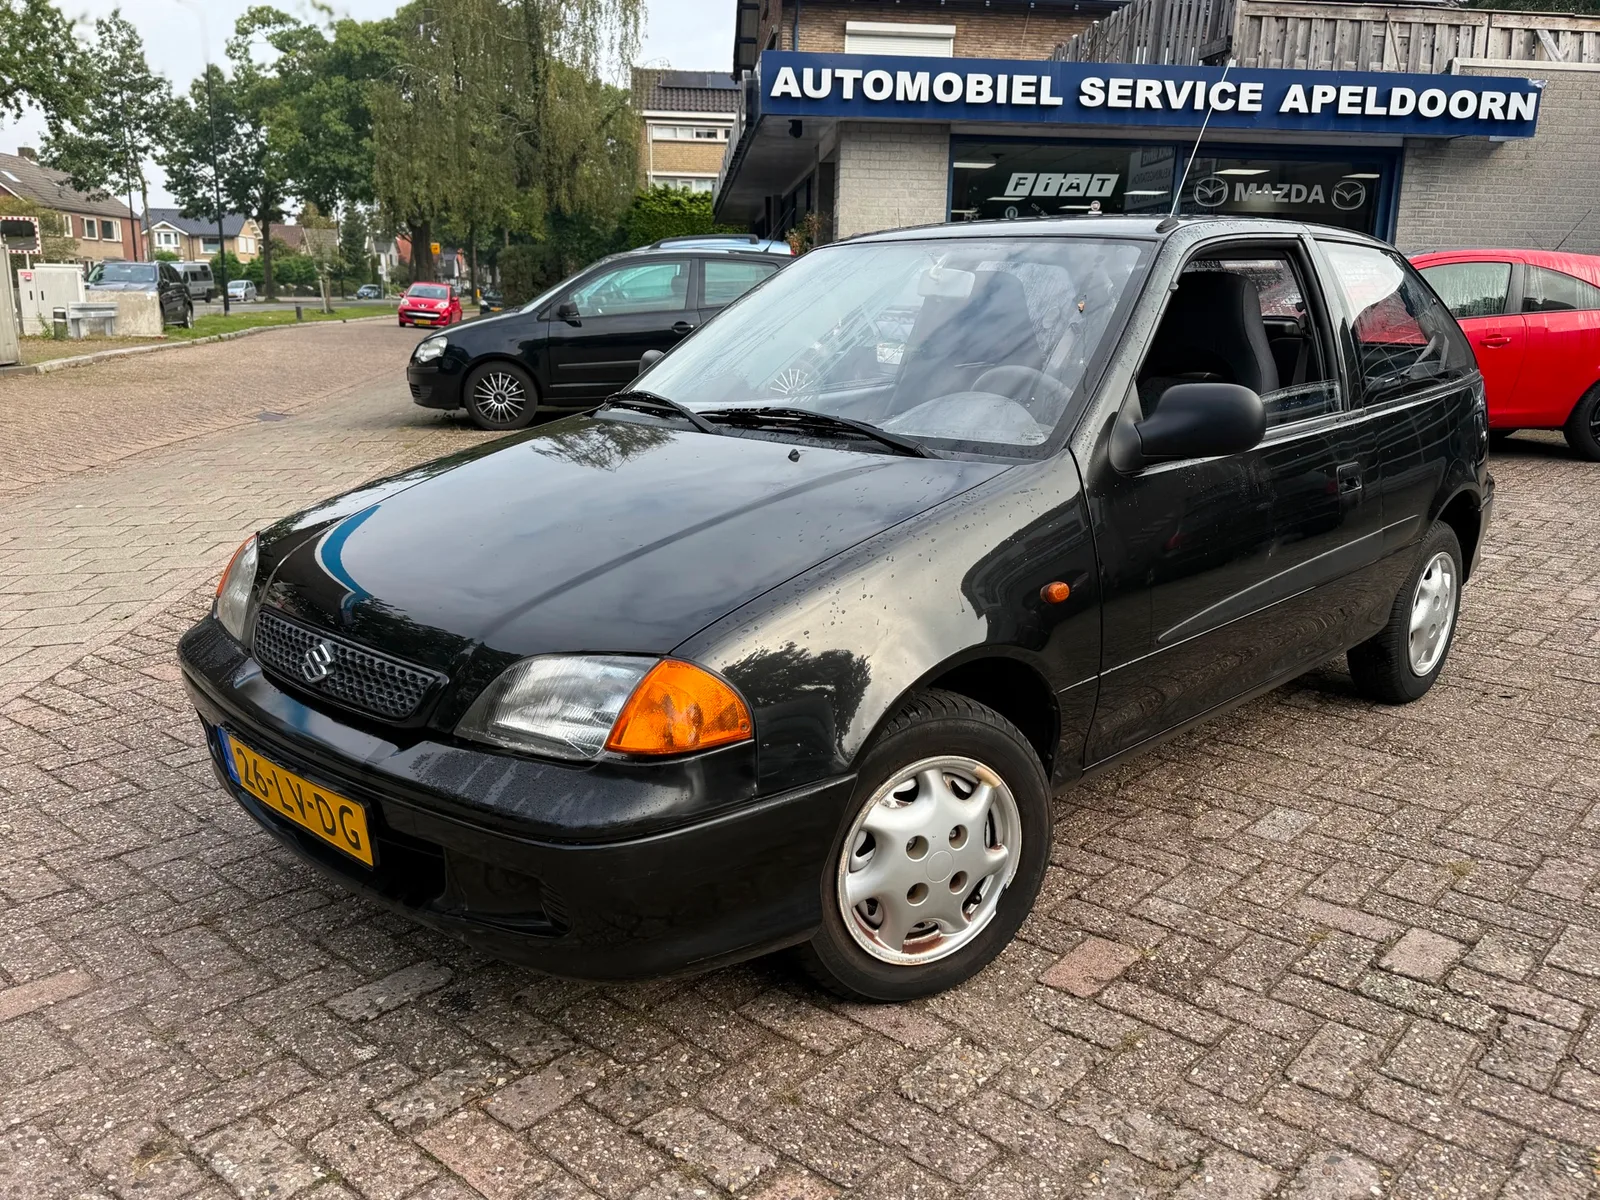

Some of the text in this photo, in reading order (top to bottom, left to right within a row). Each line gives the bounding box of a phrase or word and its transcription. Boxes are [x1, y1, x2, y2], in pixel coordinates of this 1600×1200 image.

[770, 67, 1539, 122] AUTOMOBIEL SERVICE APELDOORN
[1234, 182, 1326, 204] MAZDA
[236, 747, 362, 851] 26-LV-DG
